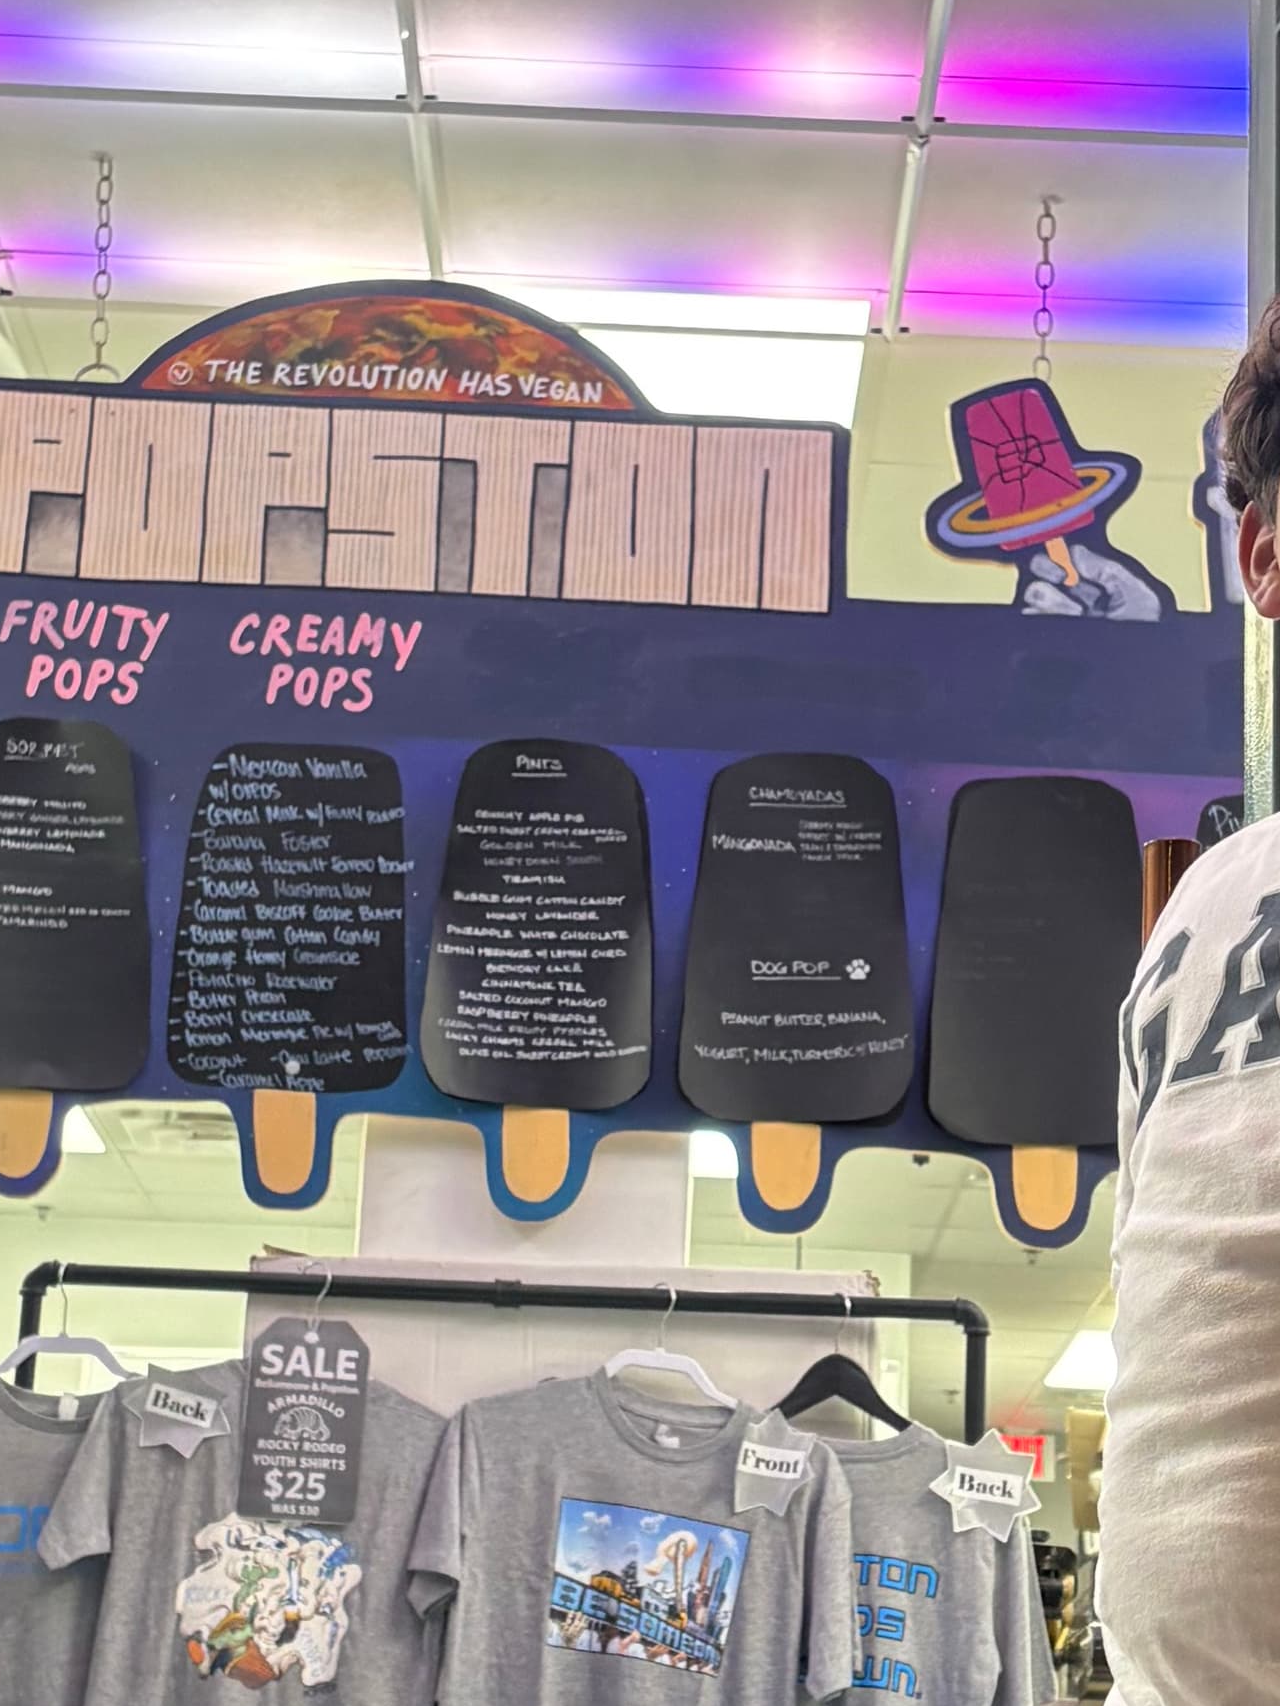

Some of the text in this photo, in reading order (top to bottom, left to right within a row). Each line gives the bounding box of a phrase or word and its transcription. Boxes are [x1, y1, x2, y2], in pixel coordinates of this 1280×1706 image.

[204, 360, 604, 404] THE REVOLUTION HAS VEGAN
[229, 612, 422, 671] CREAMY
[26, 654, 144, 705] POPS
[265, 663, 374, 712] POPS
[751, 960, 830, 975] DOG POP
[260, 1343, 360, 1381] SALE
[152, 1388, 208, 1423] Back
[267, 1393, 345, 1419] ARMADILLO
[253, 1454, 346, 1471] YOUTH SHIRTS
[741, 1448, 801, 1474] Front
[264, 1468, 326, 1501] $25
[957, 1473, 1014, 1500] Back
